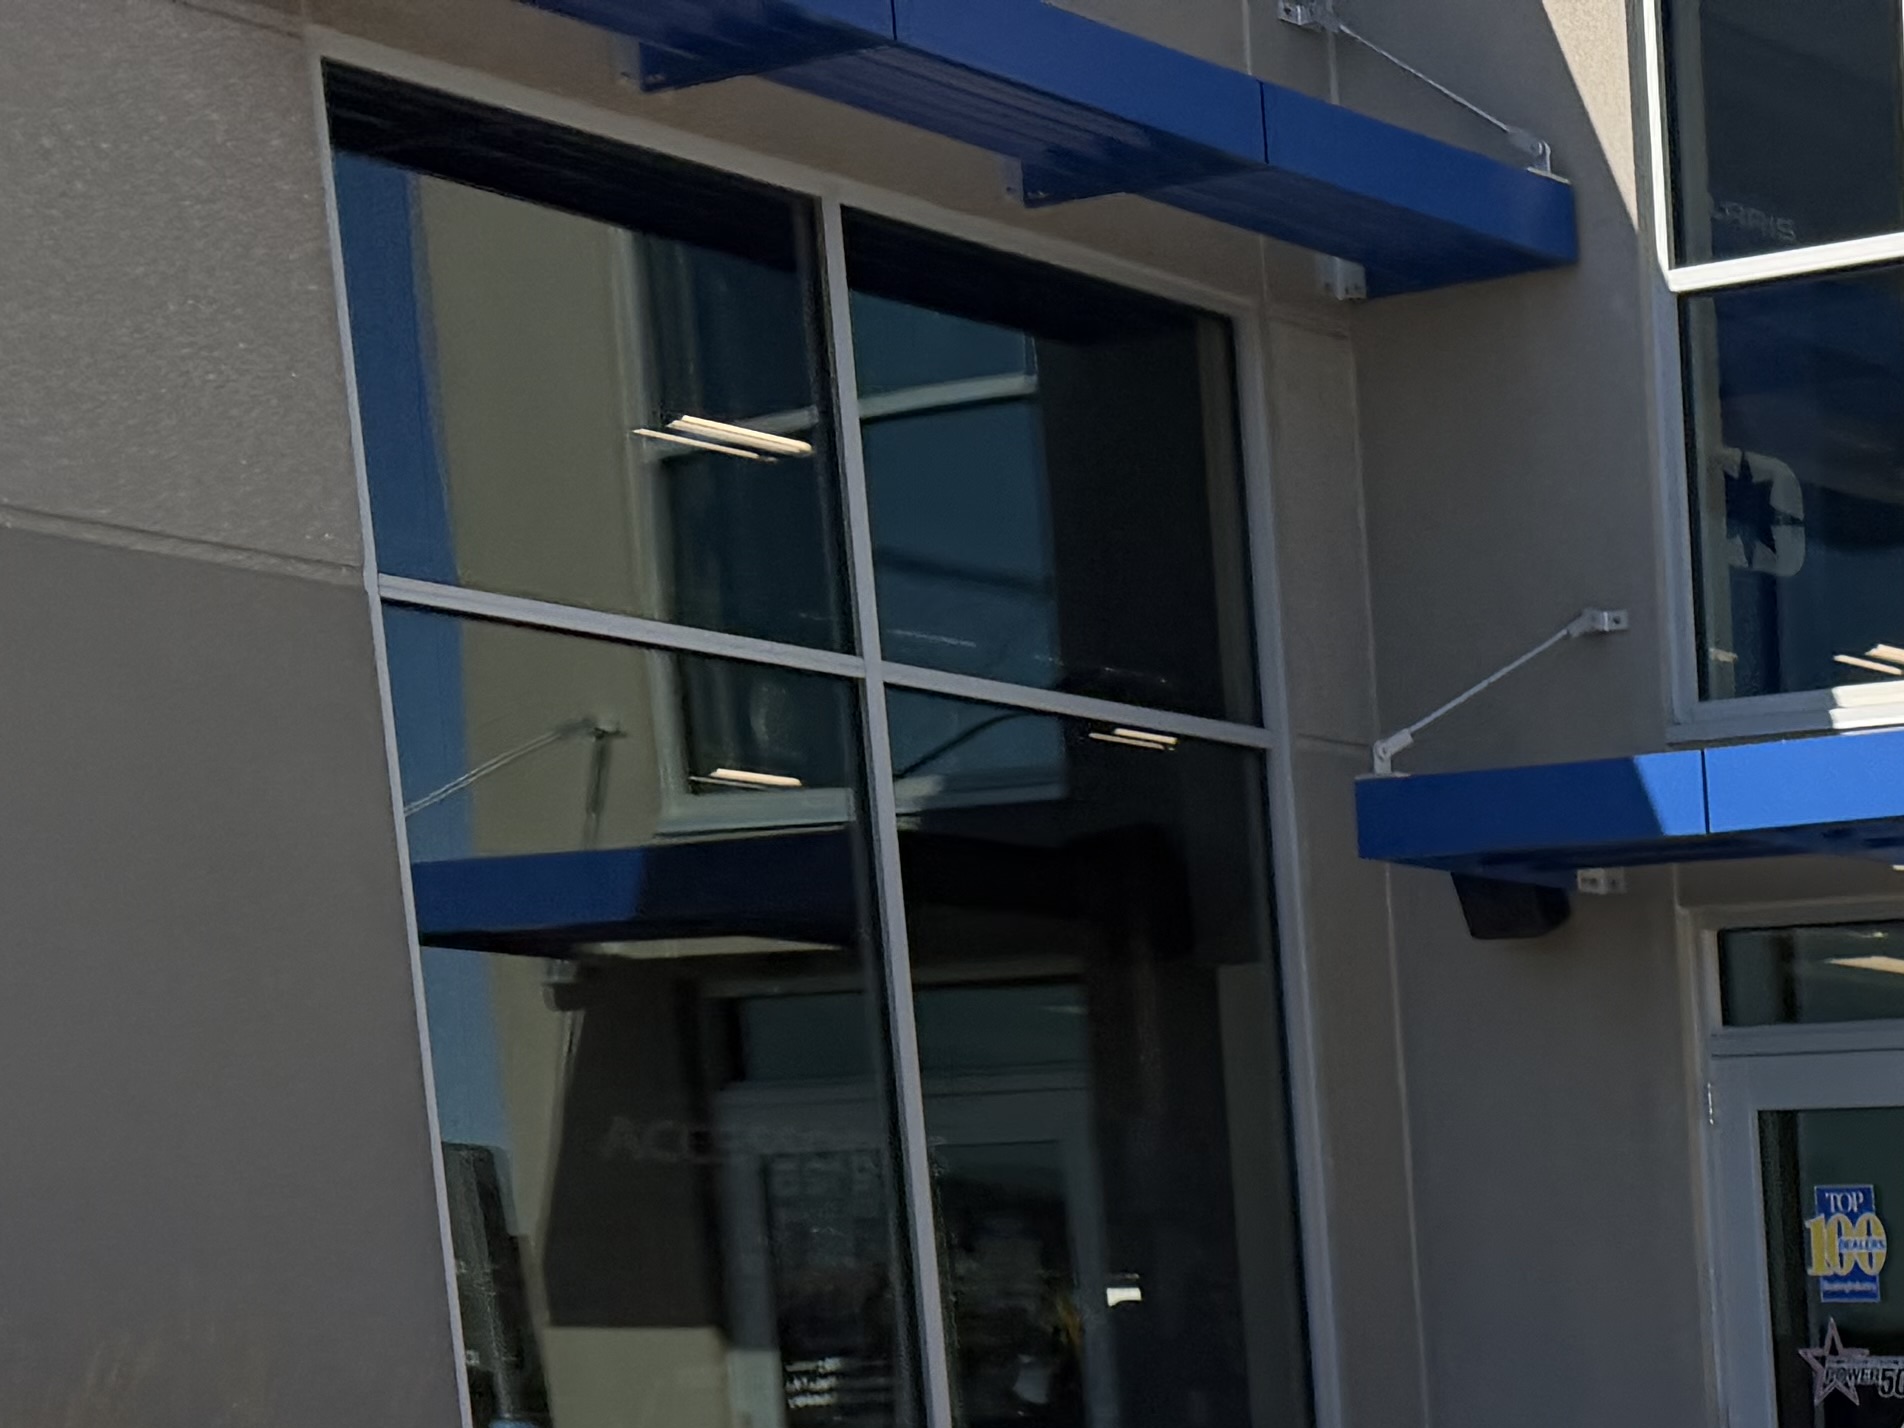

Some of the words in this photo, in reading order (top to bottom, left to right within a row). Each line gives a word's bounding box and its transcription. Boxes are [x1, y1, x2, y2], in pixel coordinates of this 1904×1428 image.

[1825, 1191, 1864, 1213] TOP
[1804, 1212, 1888, 1277] 100
[1825, 1366, 1881, 1384] POWER
